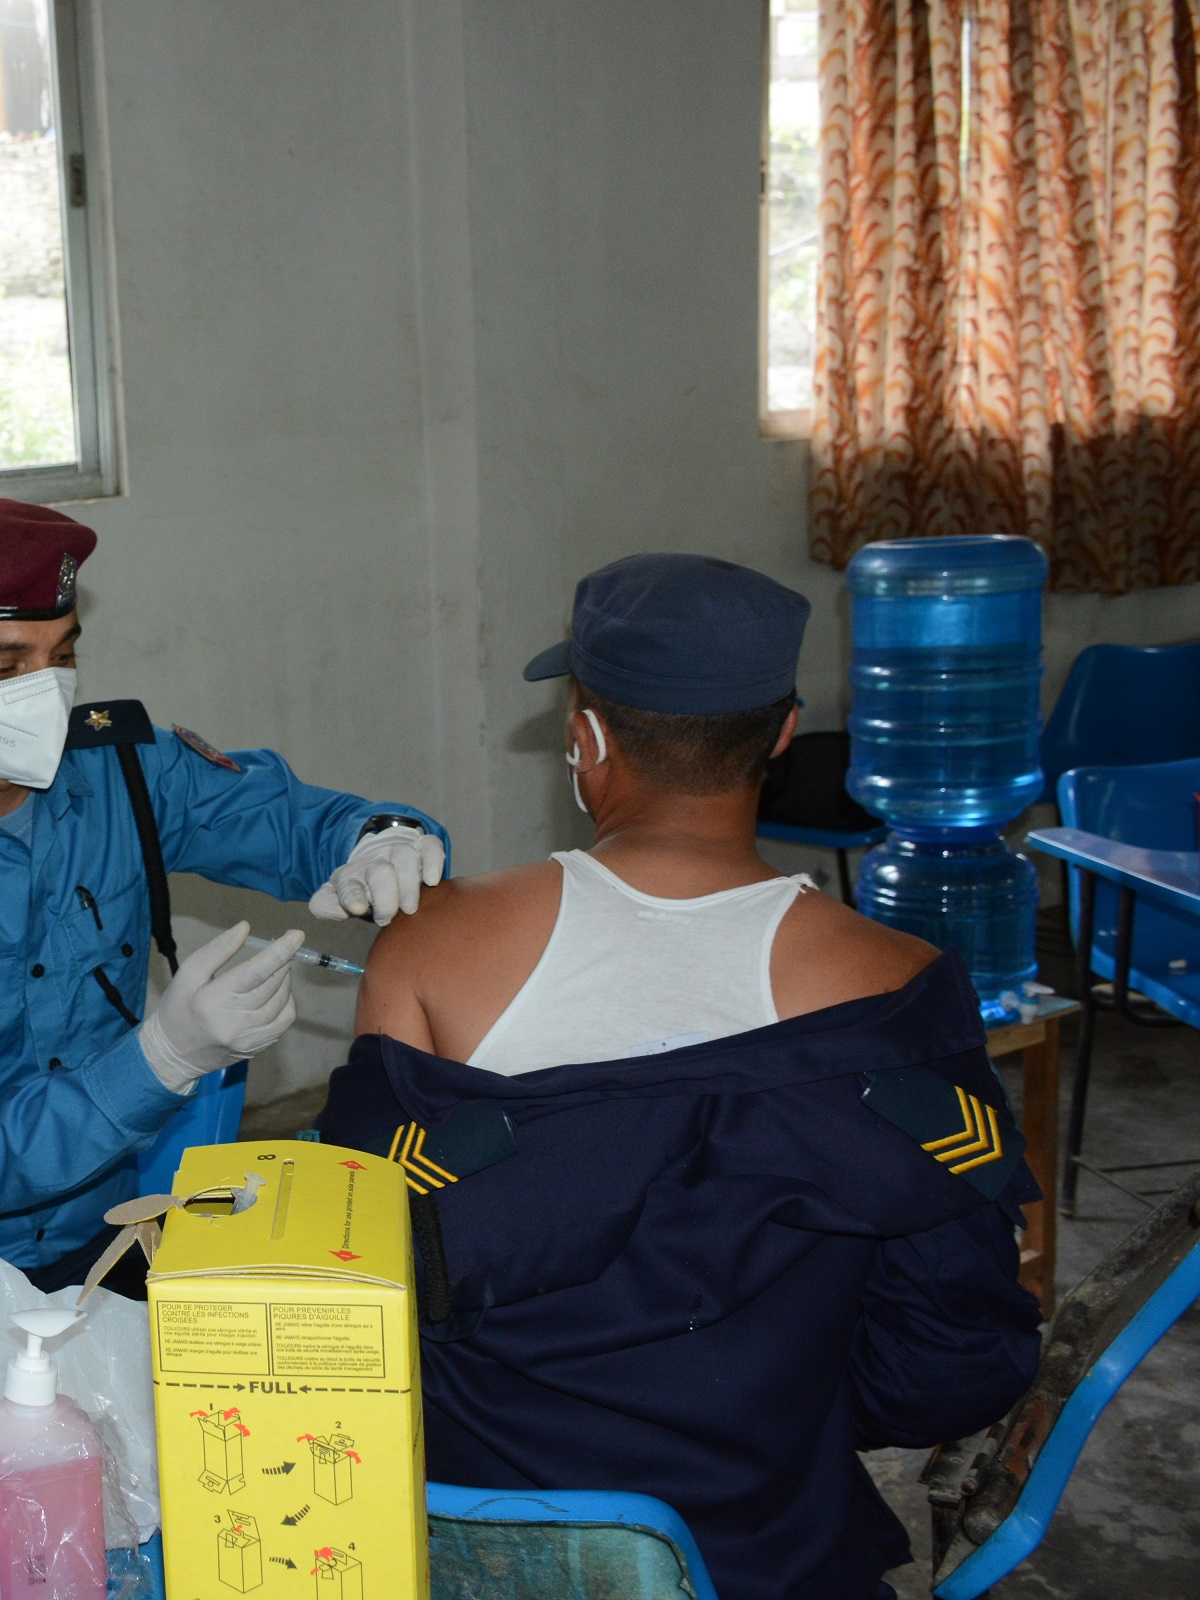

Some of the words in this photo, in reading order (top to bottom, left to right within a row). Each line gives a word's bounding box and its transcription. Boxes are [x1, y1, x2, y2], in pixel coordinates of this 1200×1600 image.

[250, 1382, 298, 1394] FULL
[214, 1515, 221, 1523] 3
[348, 1542, 356, 1551] 4
